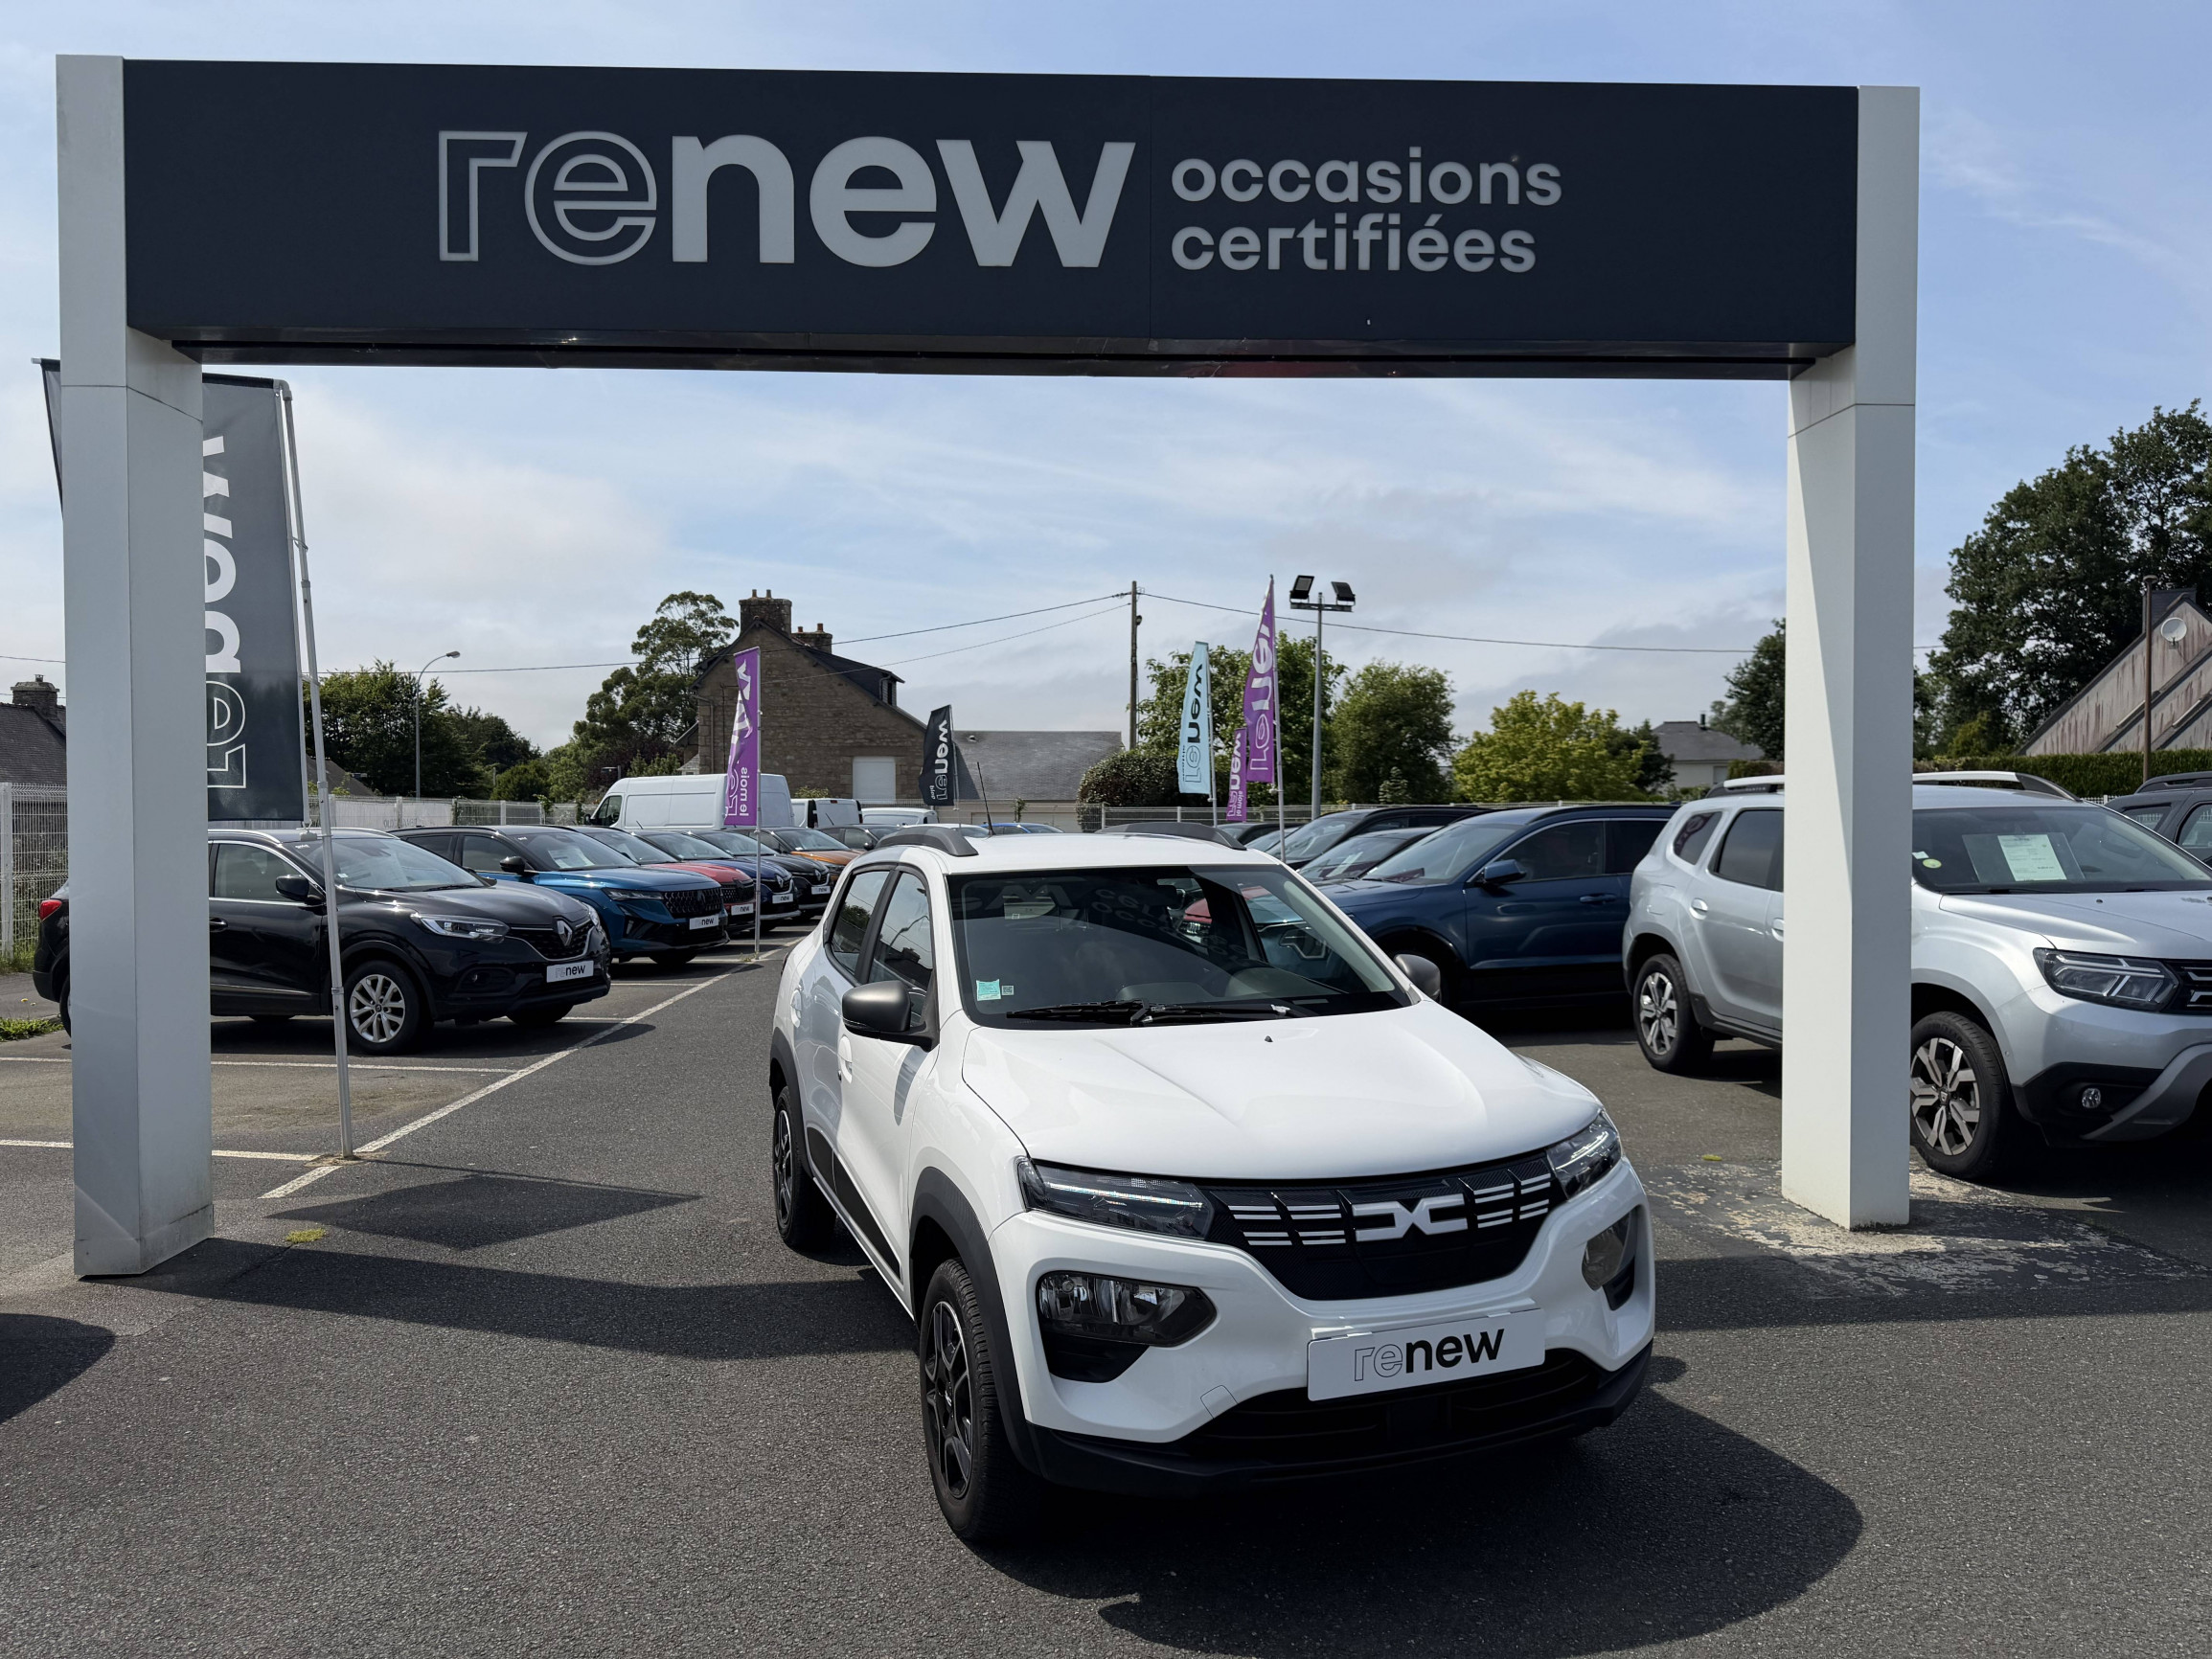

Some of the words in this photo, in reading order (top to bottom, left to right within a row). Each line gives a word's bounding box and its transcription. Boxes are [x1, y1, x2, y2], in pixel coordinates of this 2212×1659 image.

[438, 130, 1137, 268] renew
[1171, 146, 1562, 206] occasions
[1171, 213, 1537, 273] certifiées
[1354, 1329, 1505, 1381] renew
